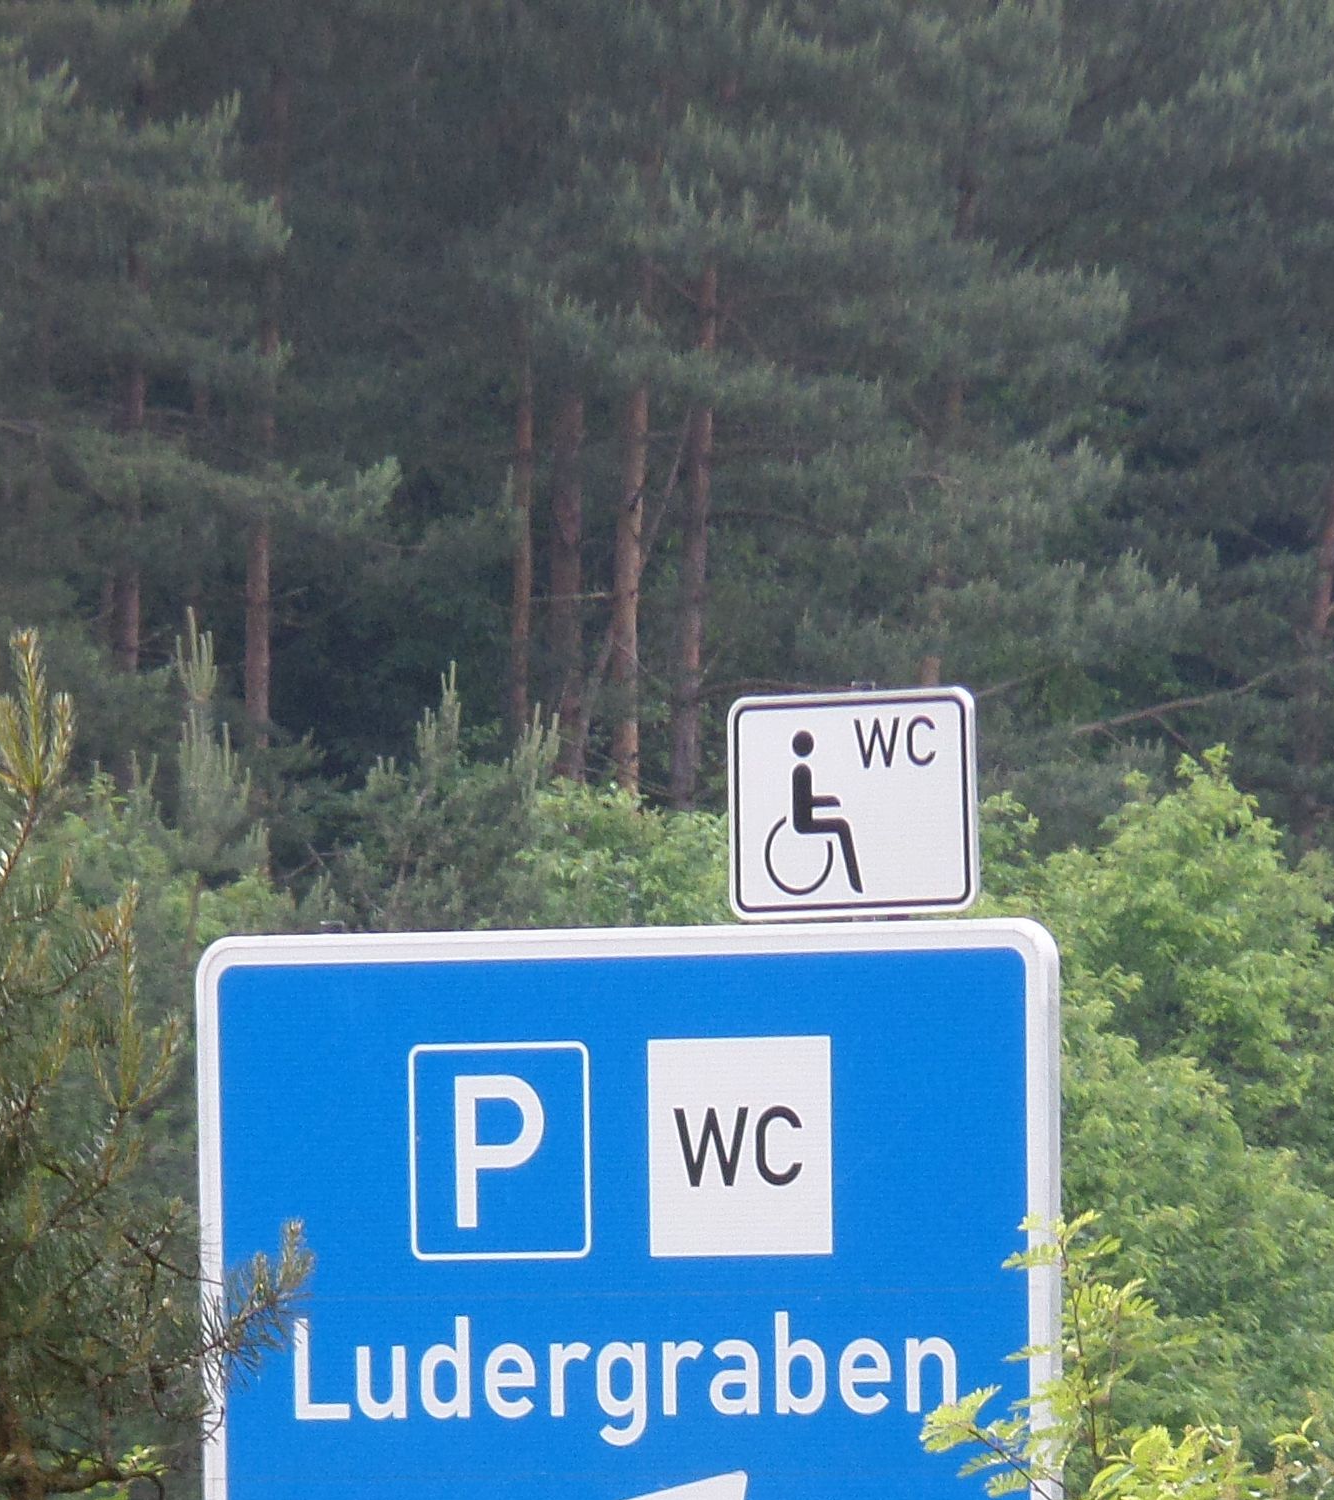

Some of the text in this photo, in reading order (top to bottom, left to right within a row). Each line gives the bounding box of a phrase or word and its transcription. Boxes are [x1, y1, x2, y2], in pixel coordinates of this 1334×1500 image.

[854, 715, 937, 769] WC
[454, 1074, 545, 1229] P
[673, 1106, 802, 1187] WC
[292, 1311, 958, 1448] Ludergraben
